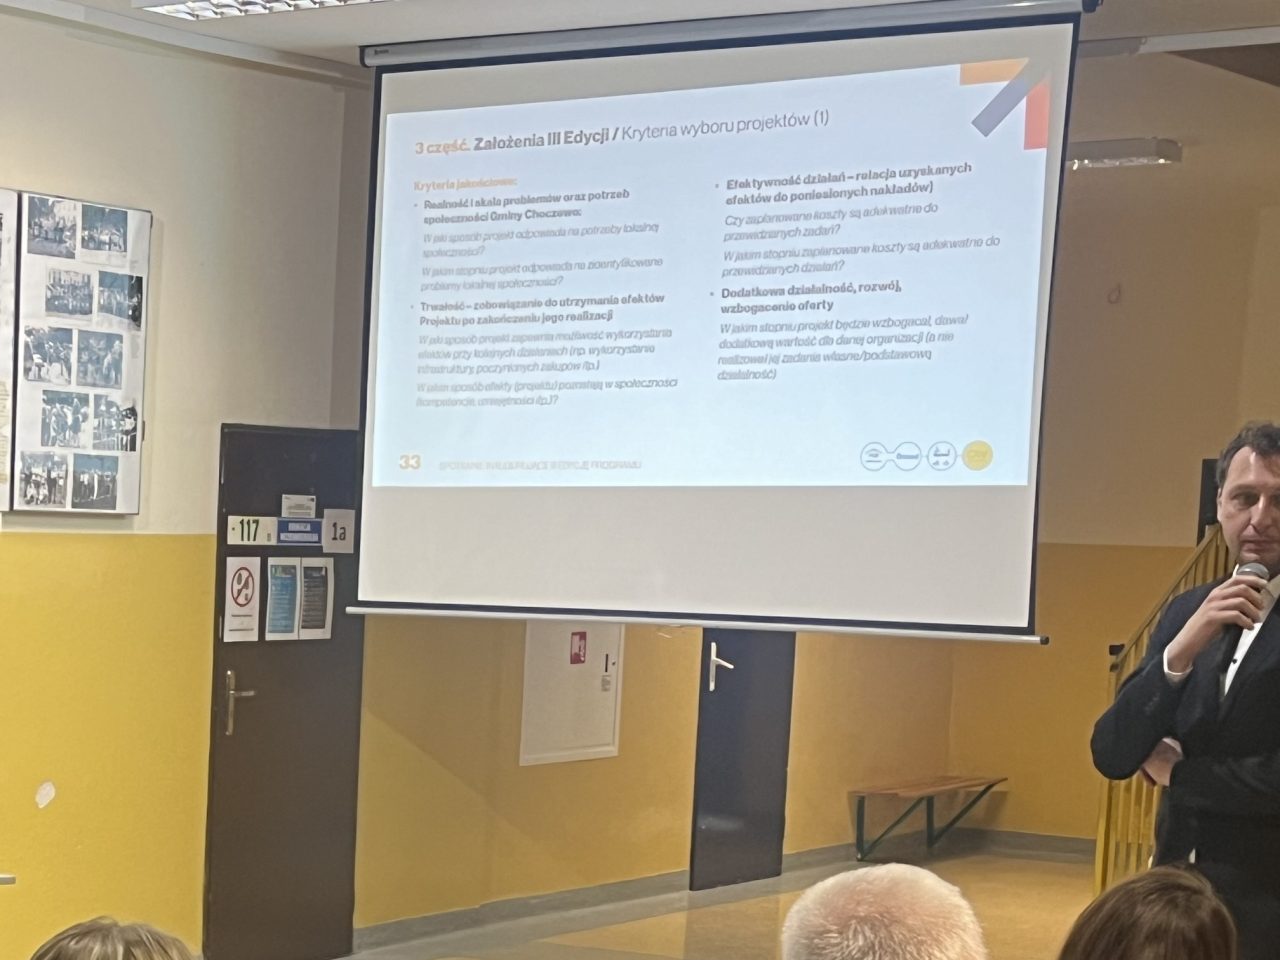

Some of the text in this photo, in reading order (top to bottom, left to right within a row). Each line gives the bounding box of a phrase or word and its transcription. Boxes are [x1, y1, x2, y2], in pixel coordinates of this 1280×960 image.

[415, 142, 424, 154] 3
[473, 133, 544, 151] Założenia
[547, 131, 561, 146] III
[563, 127, 609, 146] Edycji
[612, 127, 620, 141] /
[621, 124, 677, 142] Kryteria
[680, 120, 734, 138] wyboru
[736, 112, 810, 133] projektów
[726, 174, 801, 191] Efektywność
[803, 171, 846, 185] działań
[856, 168, 896, 182] relacja
[898, 162, 972, 180] uzyskanych
[503, 194, 562, 208] problemów
[563, 193, 586, 203] oraz
[588, 189, 630, 203] potrzeb
[726, 180, 933, 206] efektów do poniesionych nakładów)
[490, 209, 523, 222] Gminy
[725, 215, 745, 228] Czy
[813, 209, 847, 222] koszty
[923, 202, 939, 214] do
[985, 235, 1001, 247] do
[544, 297, 558, 308] do
[559, 294, 619, 308] utrzymania
[621, 293, 665, 305] efektów
[721, 286, 785, 299] Dodatkowa
[720, 299, 834, 315] wzbogacenie oferty
[419, 316, 461, 328] Projektu
[462, 317, 475, 327] po
[541, 312, 564, 324] jego
[399, 454, 422, 469] 33
[239, 518, 260, 542] 117
[331, 521, 347, 541] 1a
